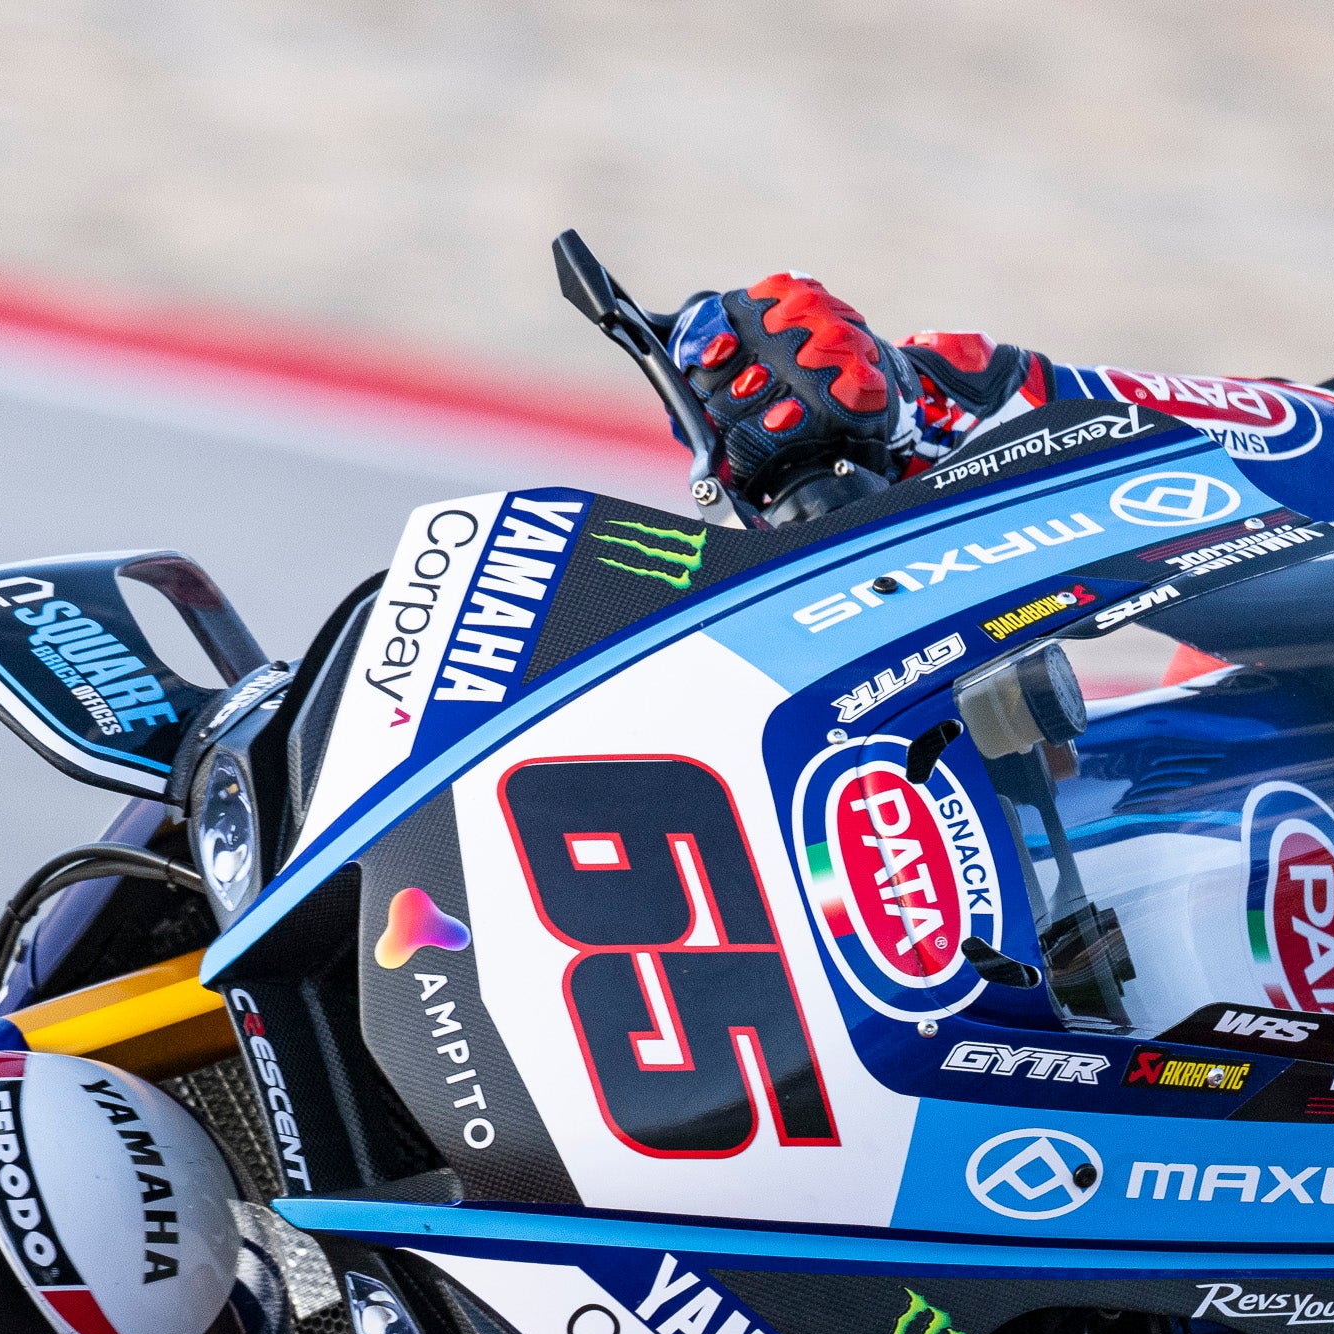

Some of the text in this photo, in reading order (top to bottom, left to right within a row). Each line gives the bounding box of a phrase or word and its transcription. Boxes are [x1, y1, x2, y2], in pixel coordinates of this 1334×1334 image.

[1196, 428, 1265, 454] SNA
[365, 509, 479, 702] Corpay
[433, 496, 584, 703] YAMAHA
[792, 512, 1106, 633] MAXUS
[1095, 585, 1180, 629] WRS
[13, 599, 179, 733] SQUARE
[31, 645, 124, 737] BRICK OFFICES
[830, 632, 967, 723] GYTR
[849, 788, 945, 957] PATA
[939, 798, 993, 910] SNACK
[498, 755, 842, 1159] 65
[230, 988, 312, 1192] CRESCENT
[414, 973, 496, 1149] AMPITO
[940, 1041, 1111, 1086] GYTR
[1212, 1010, 1320, 1043] WRS
[80, 1079, 179, 1285] YAMAHA
